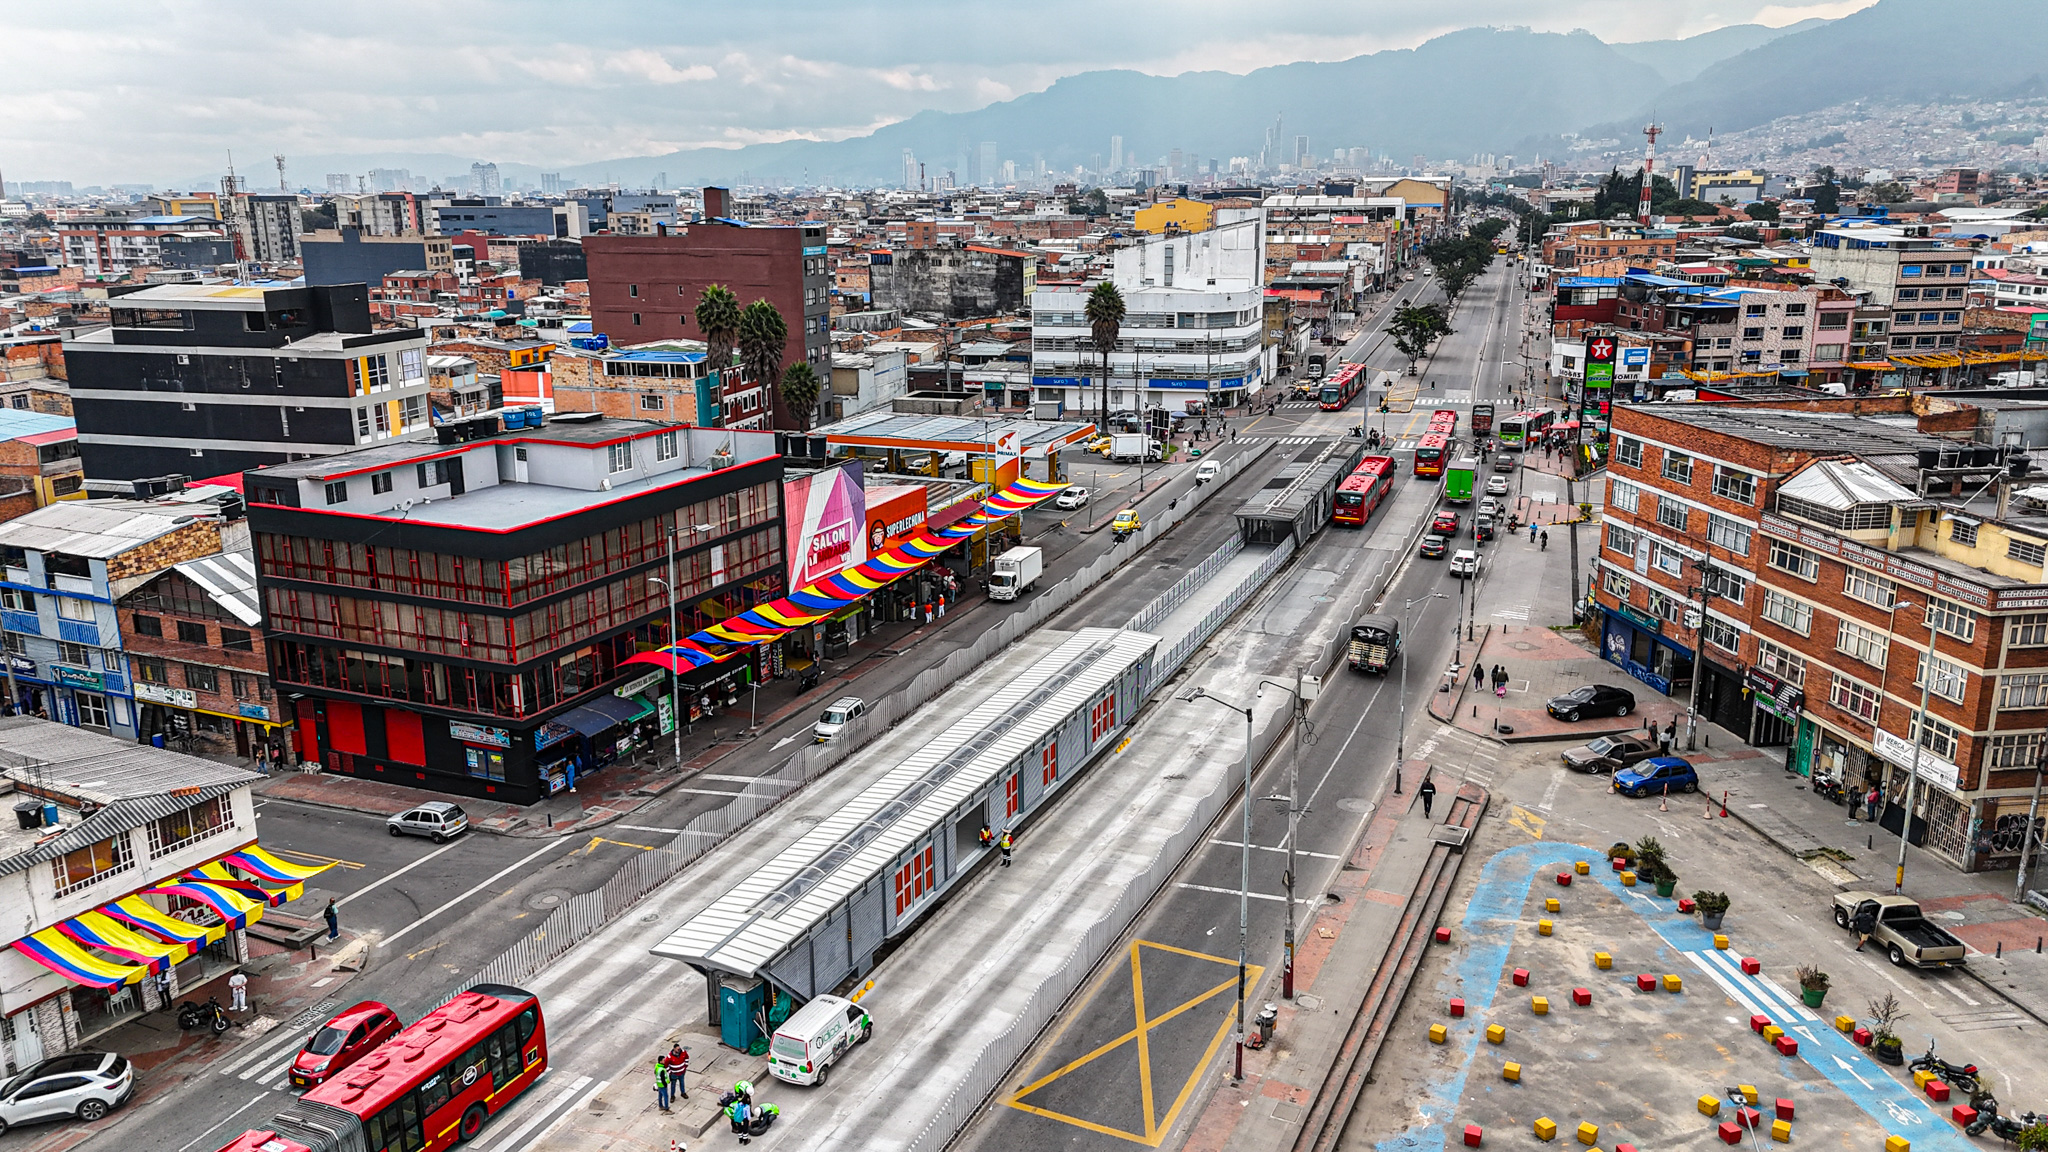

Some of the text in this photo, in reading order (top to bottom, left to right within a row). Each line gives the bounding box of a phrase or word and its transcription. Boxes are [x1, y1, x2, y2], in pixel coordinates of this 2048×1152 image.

[886, 511, 925, 538] SUPERLECHONA
[812, 527, 846, 552] SALON
[1886, 736, 1905, 751] MERCA
